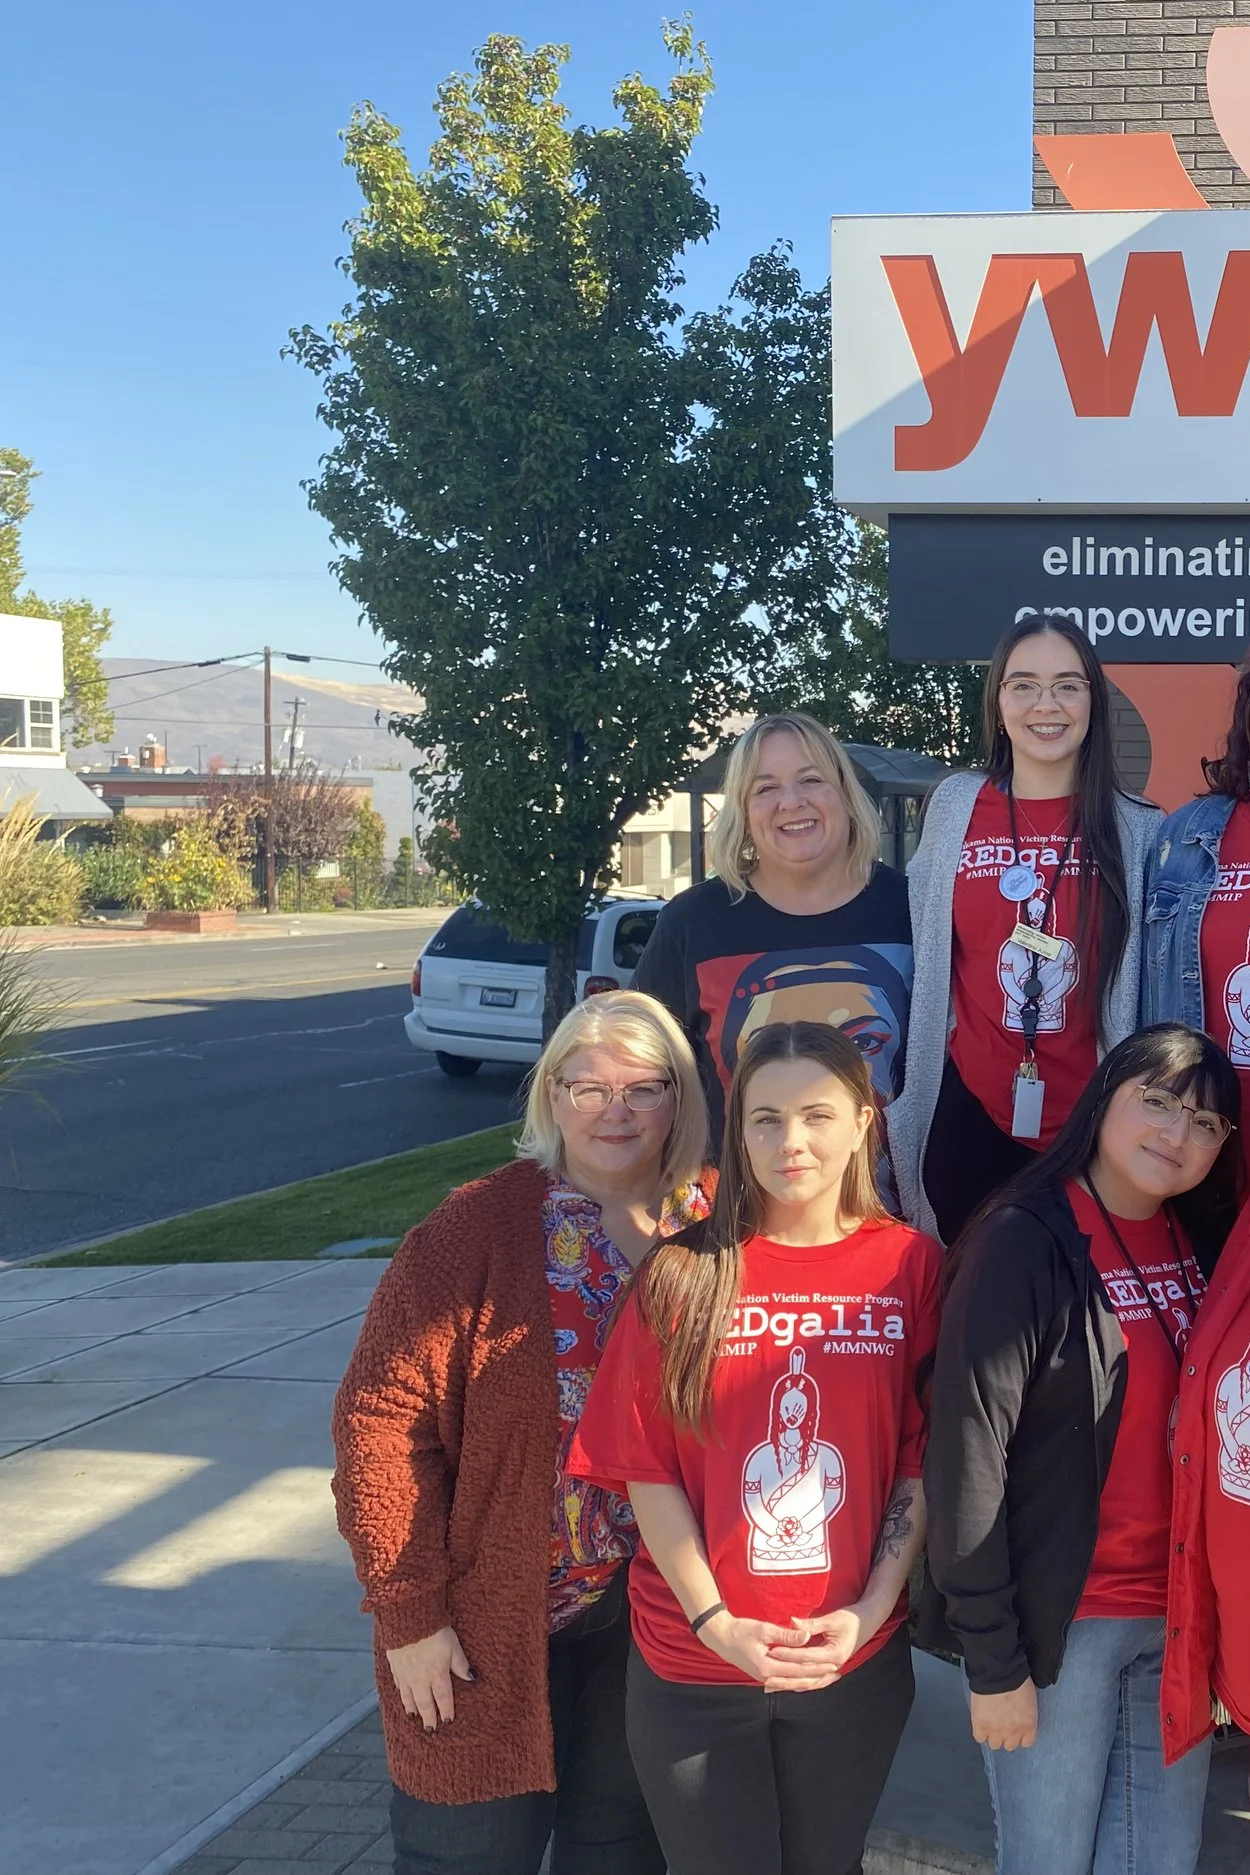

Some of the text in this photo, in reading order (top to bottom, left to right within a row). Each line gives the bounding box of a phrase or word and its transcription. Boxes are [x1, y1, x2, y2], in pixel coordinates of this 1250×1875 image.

[1020, 834, 1049, 843] Victim
[1138, 1264, 1164, 1275] Victim
[737, 1293, 769, 1304] ation
[771, 1293, 810, 1303] Victim
[812, 1292, 862, 1303] Resource
[1118, 1307, 1153, 1322] #MMIP
[823, 1341, 895, 1356] #MMNWG
